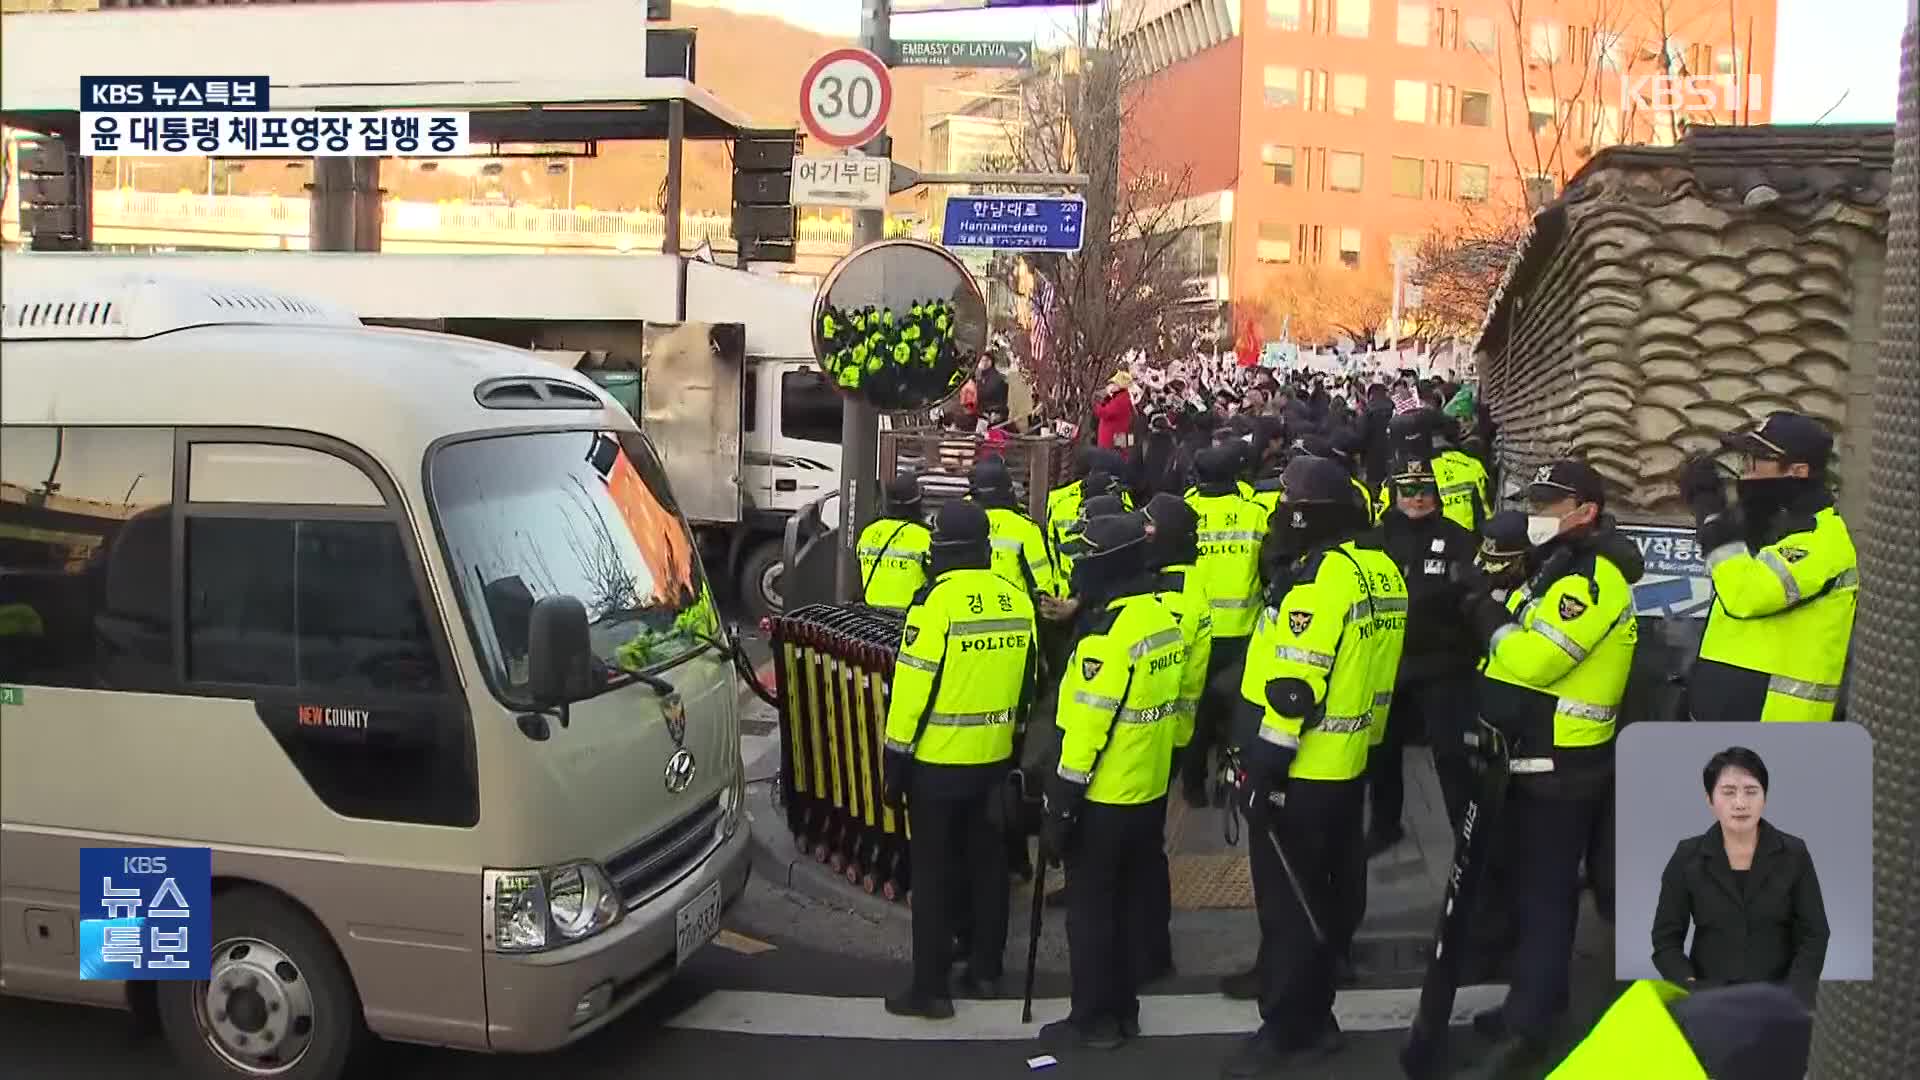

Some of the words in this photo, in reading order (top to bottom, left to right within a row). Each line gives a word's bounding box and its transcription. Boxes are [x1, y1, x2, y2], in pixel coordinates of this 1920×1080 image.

[902, 43, 948, 55] EMBASSY
[952, 43, 965, 55] OF
[969, 43, 1006, 56] LATVIA
[817, 76, 873, 119] 30
[800, 162, 881, 184] 여기부터
[973, 201, 1040, 217] 한남대로
[960, 220, 1048, 234] Hannam-daero
[1199, 545, 1249, 556] OLICE
[961, 635, 1026, 652] POLICE
[299, 704, 322, 726] NEW
[325, 706, 368, 728] COUNTY
